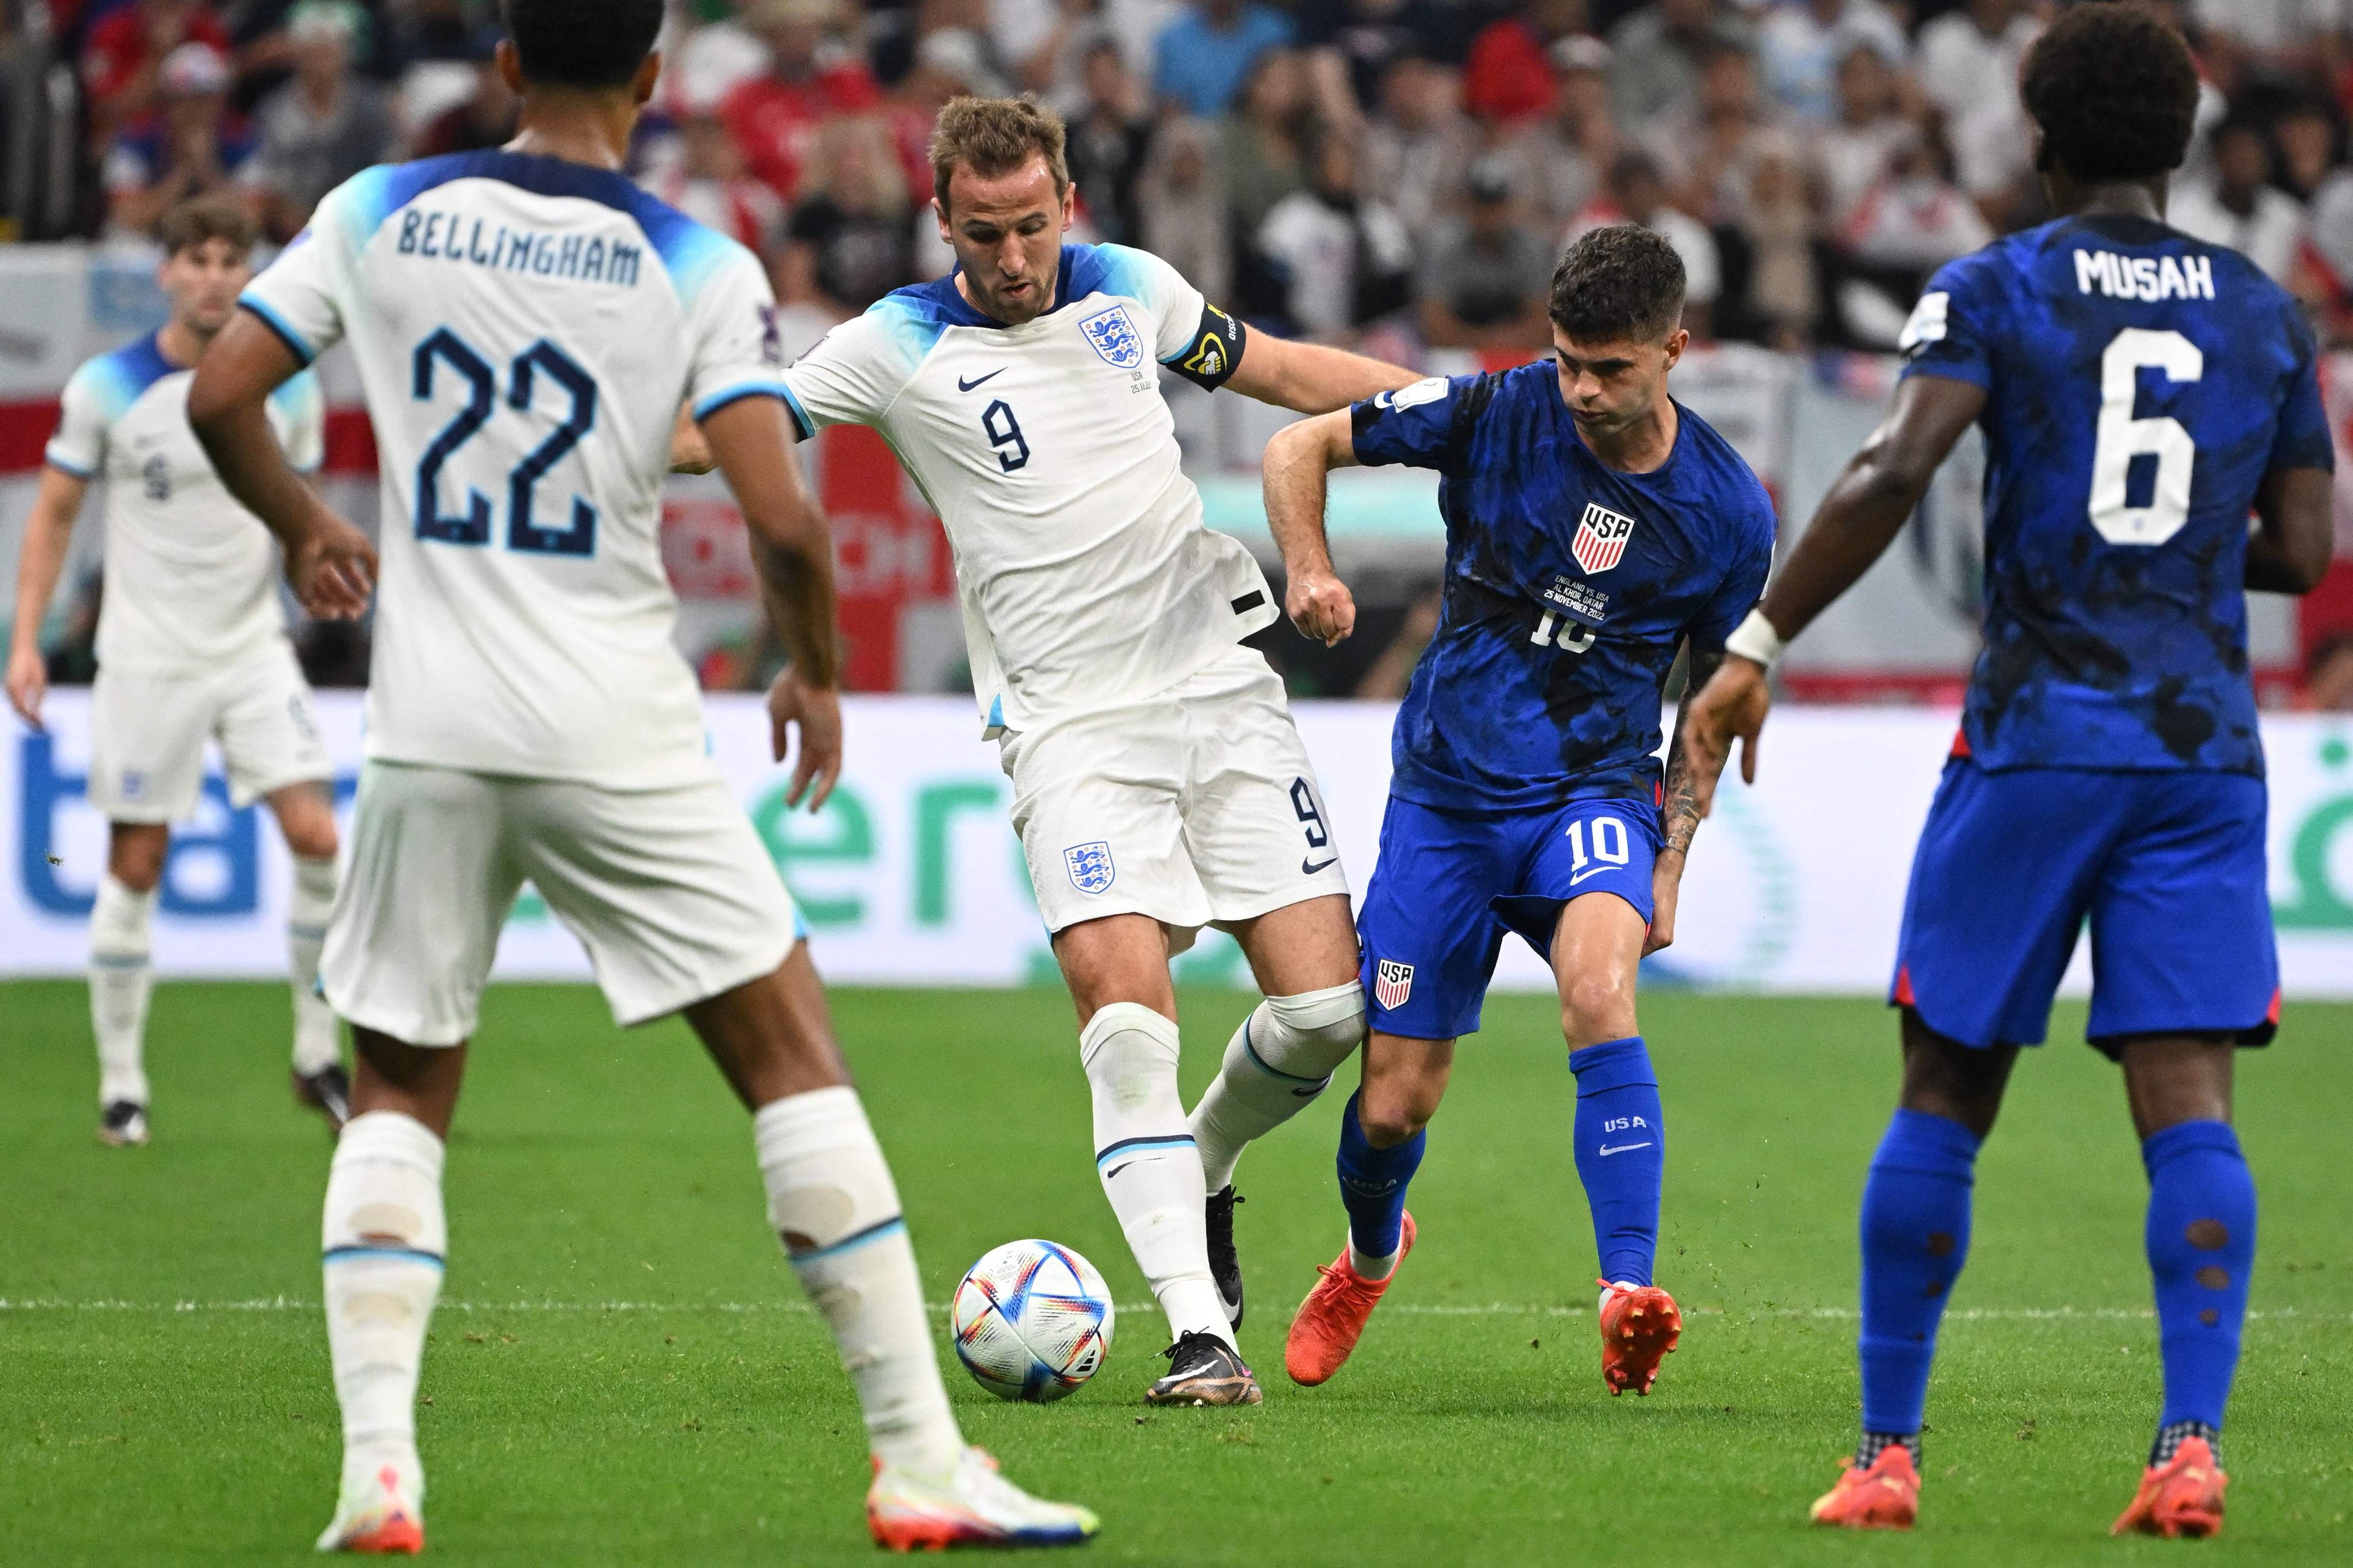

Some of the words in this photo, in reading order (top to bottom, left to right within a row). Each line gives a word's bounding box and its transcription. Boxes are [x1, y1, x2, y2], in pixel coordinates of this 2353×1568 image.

[396, 208, 642, 286] BELLINGHAM
[2073, 248, 2216, 303] MUSAH
[1130, 381, 1152, 394] 25.11.22
[1131, 370, 1144, 381] USA
[411, 326, 599, 558] 22
[981, 399, 1031, 473] 9
[2088, 326, 2204, 546] 6
[1586, 507, 1631, 539] USA
[1544, 589, 1554, 599] 25
[1553, 592, 1588, 615] NOVEMBER
[1587, 608, 1605, 621] 2022
[1553, 584, 1562, 593] AL
[1563, 586, 1582, 602] KHOR,
[1554, 574, 1586, 592] ENGLAND
[1586, 587, 1595, 597] VS.
[1596, 592, 1609, 603] USA
[1530, 607, 1596, 654] 10
[1289, 775, 1328, 848] 9
[1565, 816, 1630, 872] 10
[1380, 962, 1411, 983] USA
[1604, 1116, 1648, 1133] USA
